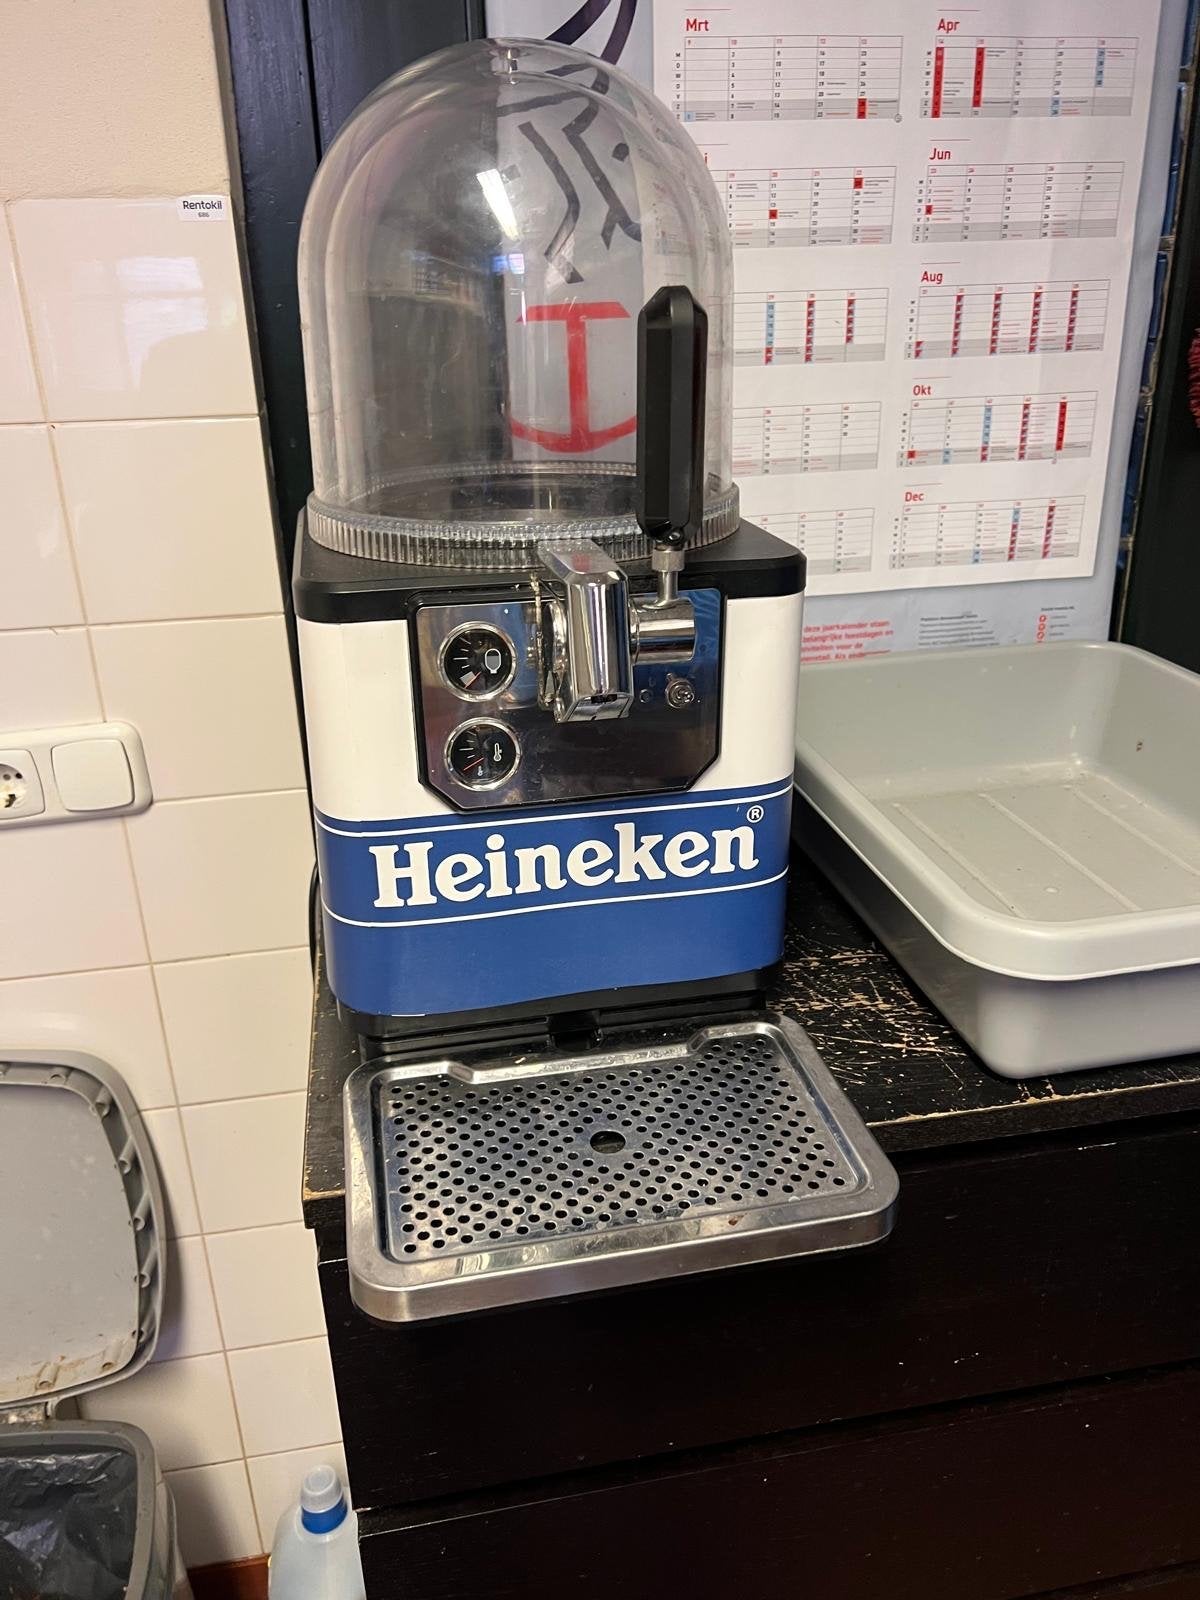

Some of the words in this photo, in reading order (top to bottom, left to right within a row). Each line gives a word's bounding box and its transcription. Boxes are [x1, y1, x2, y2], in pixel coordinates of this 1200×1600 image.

[686, 18, 709, 31] Mrt
[938, 18, 960, 33] Apr
[930, 148, 951, 160] Jun
[183, 201, 222, 209] Rentokil
[922, 271, 943, 284] Aug
[913, 384, 931, 396] Okt
[905, 491, 924, 502] Dec
[369, 823, 761, 908] Heineken
